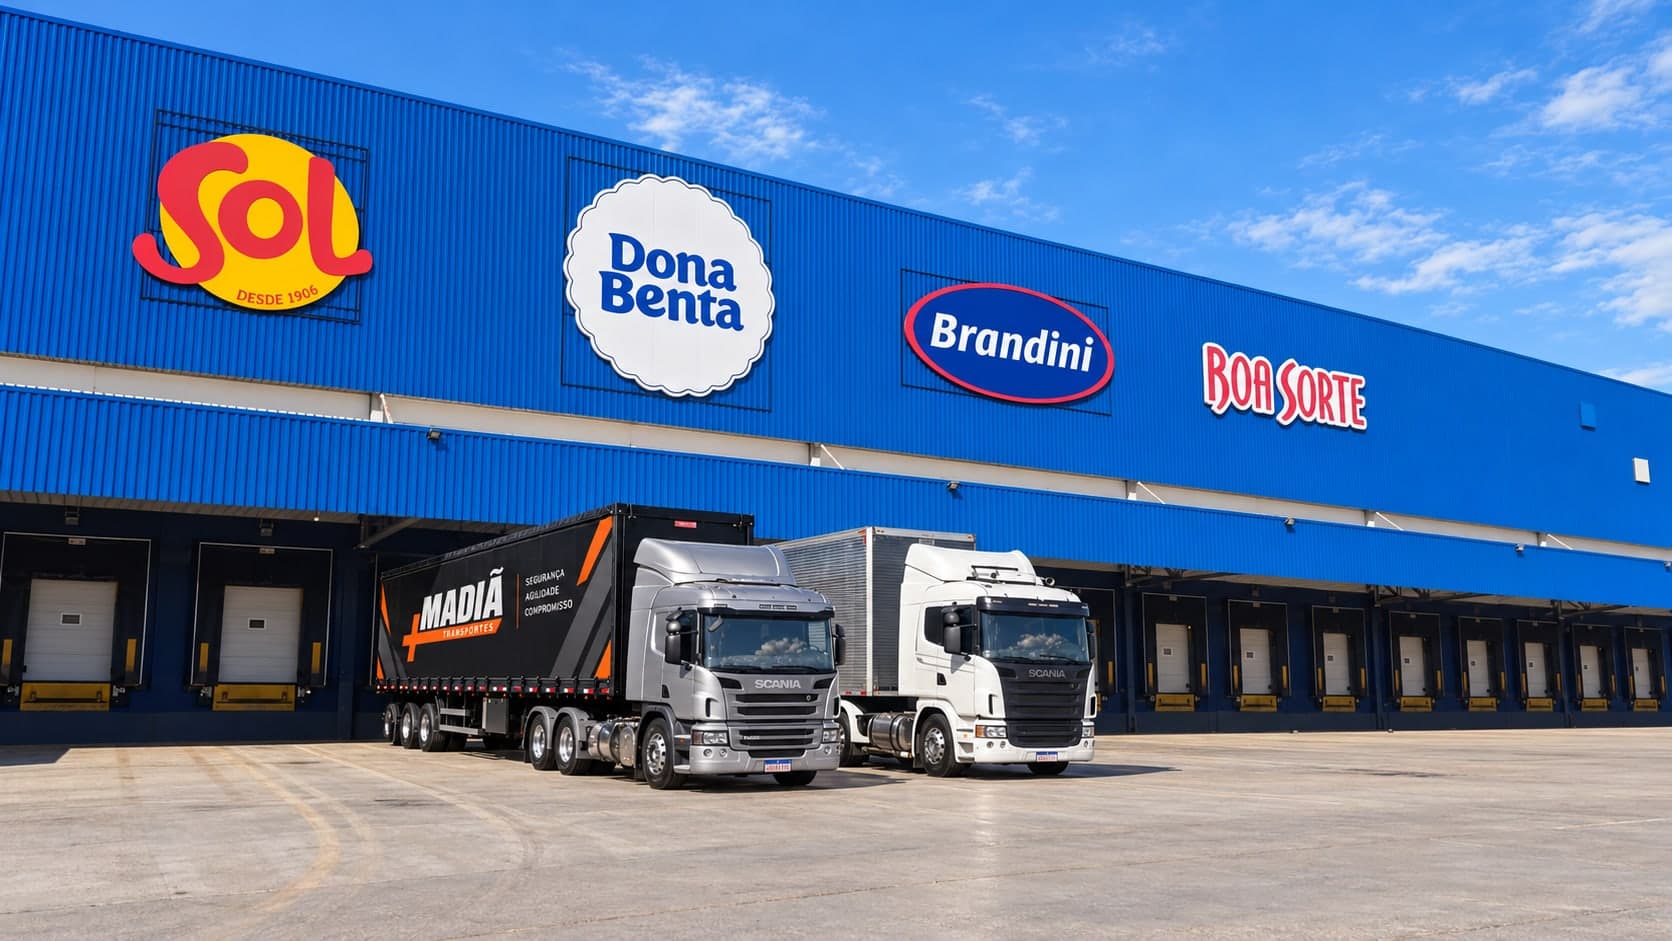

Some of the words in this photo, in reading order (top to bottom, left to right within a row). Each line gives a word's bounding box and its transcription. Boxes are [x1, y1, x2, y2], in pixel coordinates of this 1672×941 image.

[608, 232, 737, 292] Dona
[236, 289, 284, 305] DESDE
[287, 284, 319, 304] 1906
[598, 270, 744, 332] Benta
[930, 312, 1095, 373] Brandini
[1205, 344, 1273, 411] BOA
[1279, 361, 1366, 427] SORTE
[525, 568, 565, 587] SEGURANÇA
[419, 566, 504, 631] MADIÃ
[525, 585, 560, 601] AGILIDADE
[524, 599, 573, 617] COMPROMISSO
[442, 623, 494, 639] TRANSPORTES
[1028, 668, 1066, 679] SCANIA
[754, 679, 801, 689] SCANIA
